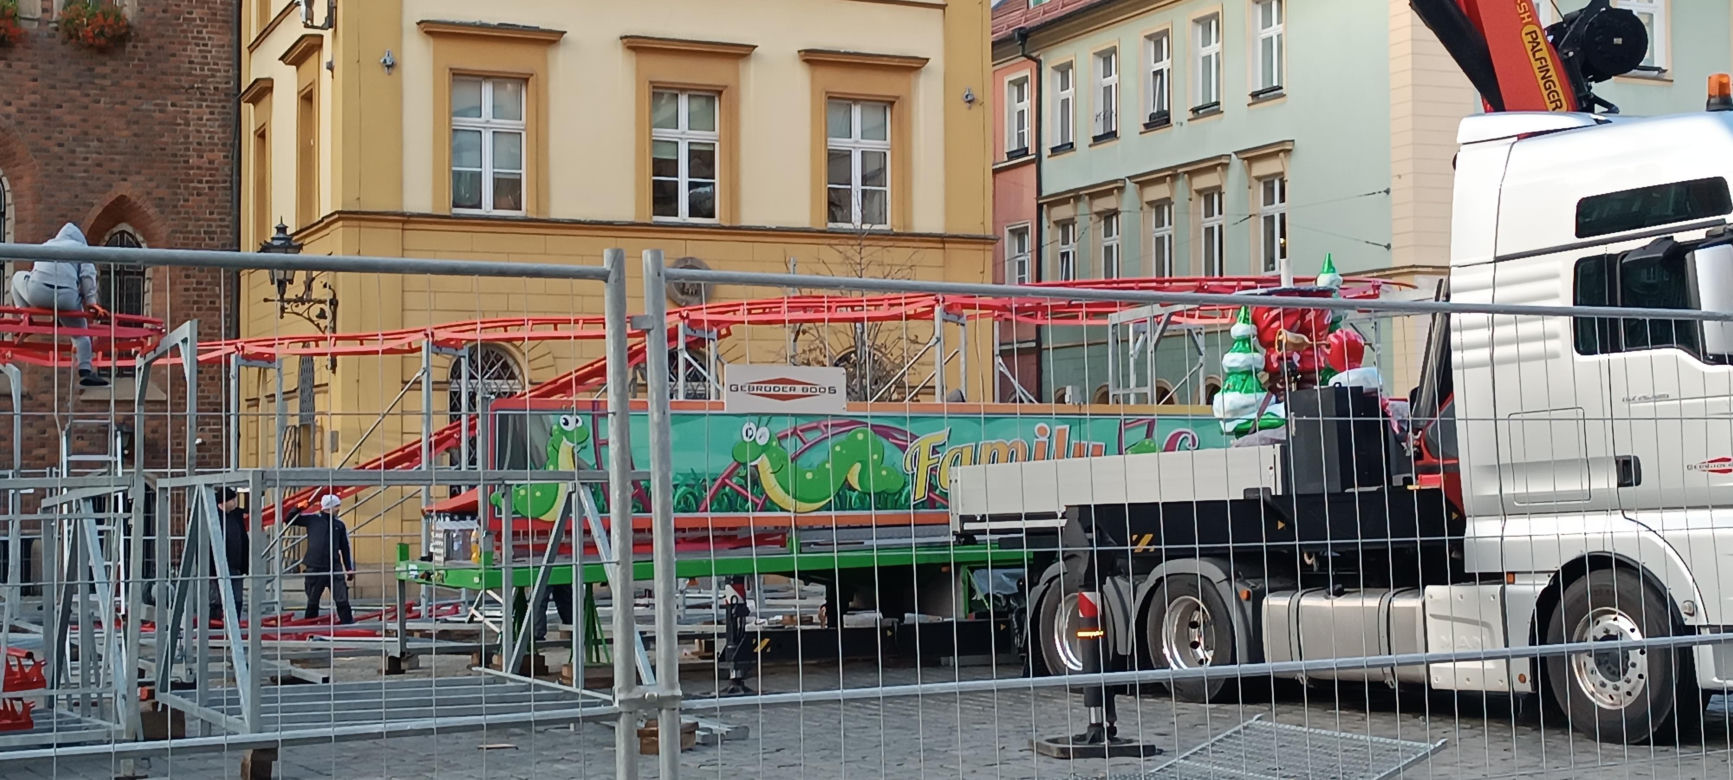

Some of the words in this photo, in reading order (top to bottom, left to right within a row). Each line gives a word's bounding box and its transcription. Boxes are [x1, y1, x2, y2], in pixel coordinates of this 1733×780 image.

[1516, 0, 1532, 23] SH
[1525, 29, 1563, 112] PALFINGER
[801, 386, 837, 395] BOOS
[903, 427, 1105, 504] Famil
